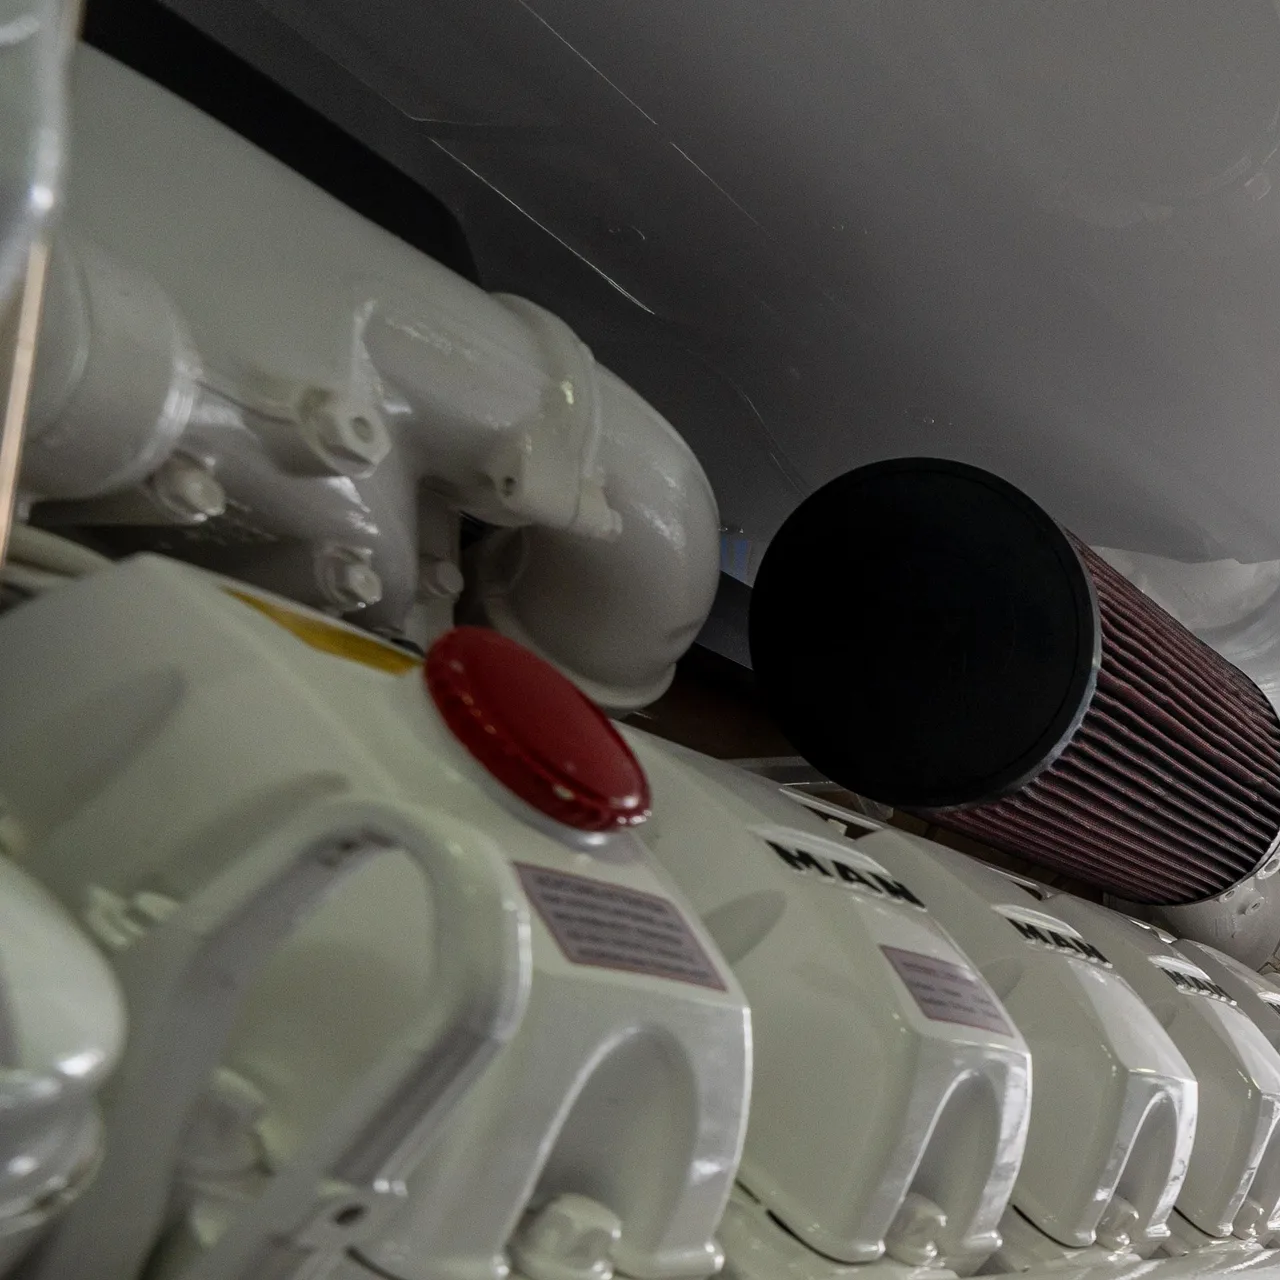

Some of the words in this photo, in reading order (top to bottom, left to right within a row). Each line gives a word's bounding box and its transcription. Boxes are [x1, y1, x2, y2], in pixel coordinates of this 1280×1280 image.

[764, 838, 926, 910] MAN
[1007, 916, 1112, 966] MAN
[1160, 966, 1237, 1005] MAN
